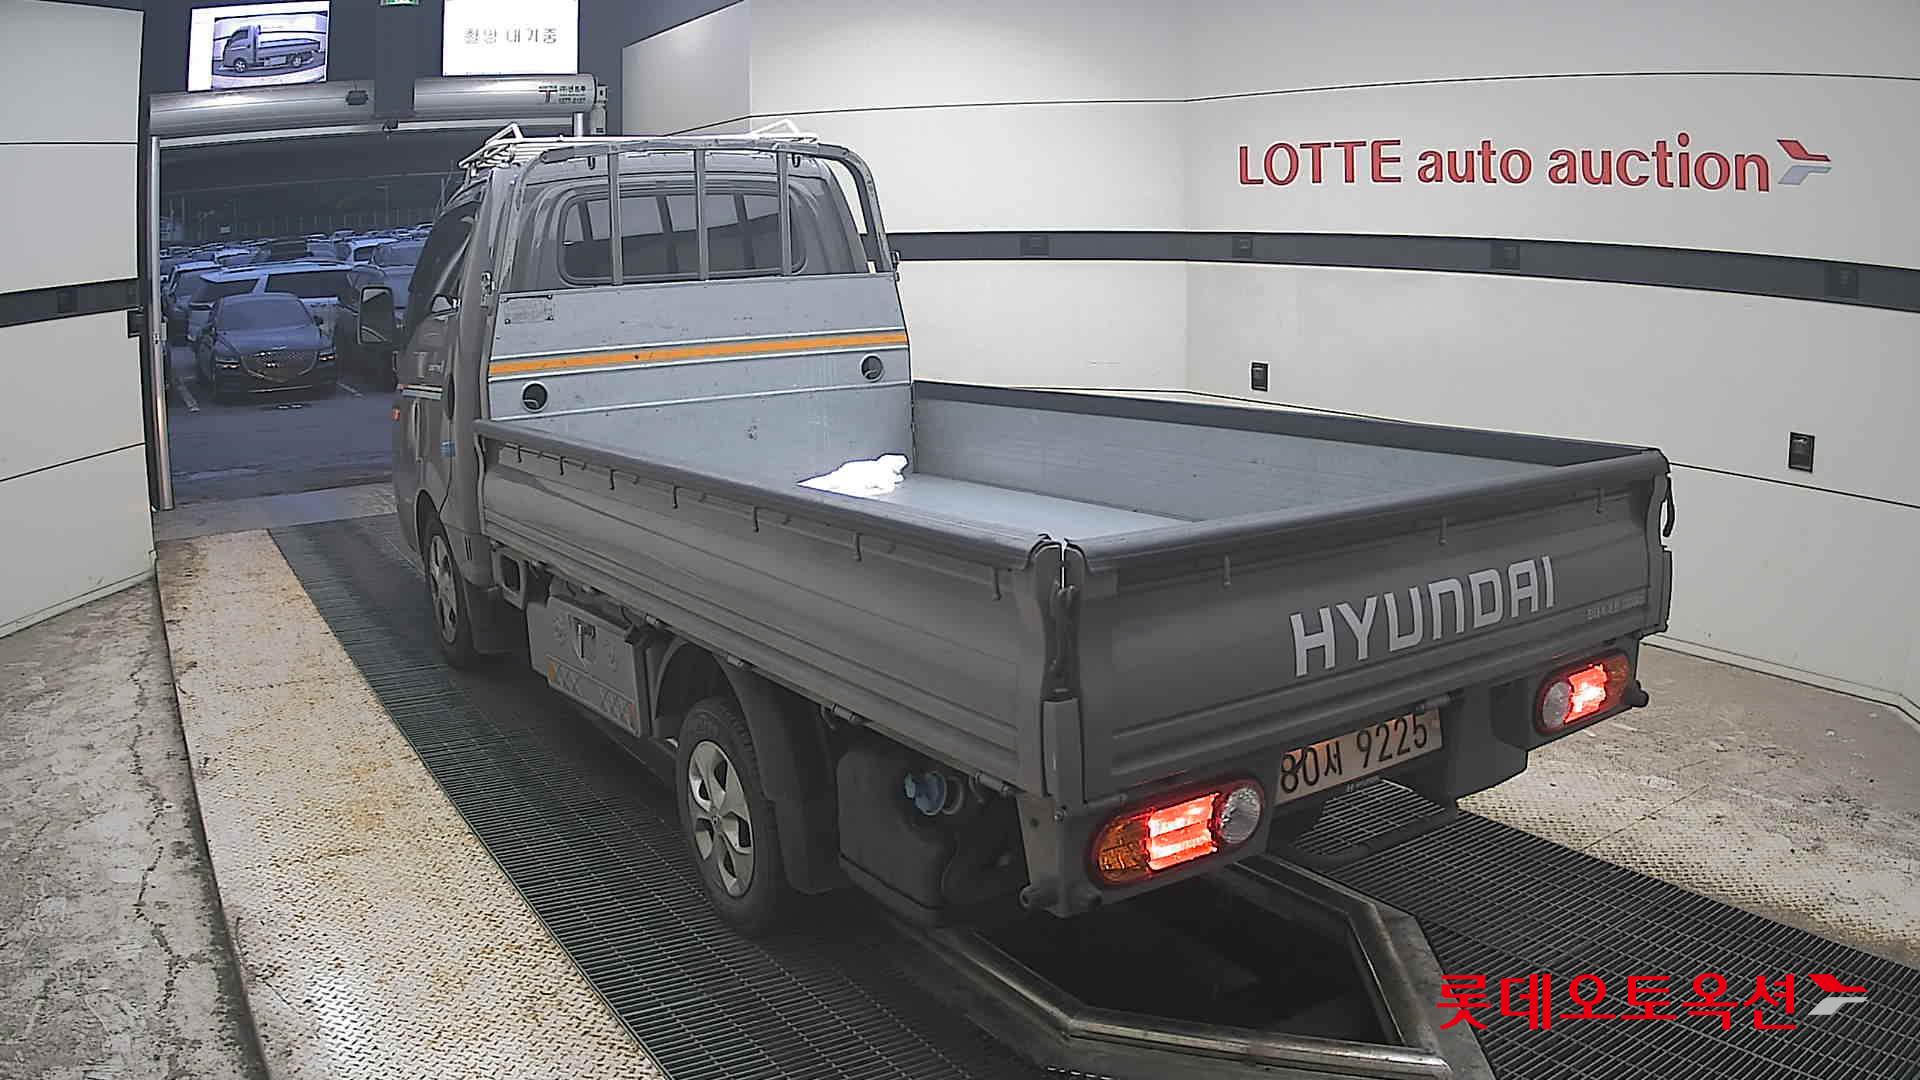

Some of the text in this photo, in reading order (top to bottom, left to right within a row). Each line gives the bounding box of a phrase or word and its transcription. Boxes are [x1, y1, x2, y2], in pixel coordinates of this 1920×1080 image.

[505, 27, 558, 45] 대기중
[1239, 132, 1770, 192] LOTTE auto auction
[1290, 555, 1556, 677] HYUNDAI
[1280, 713, 1428, 794] 80서 9225
